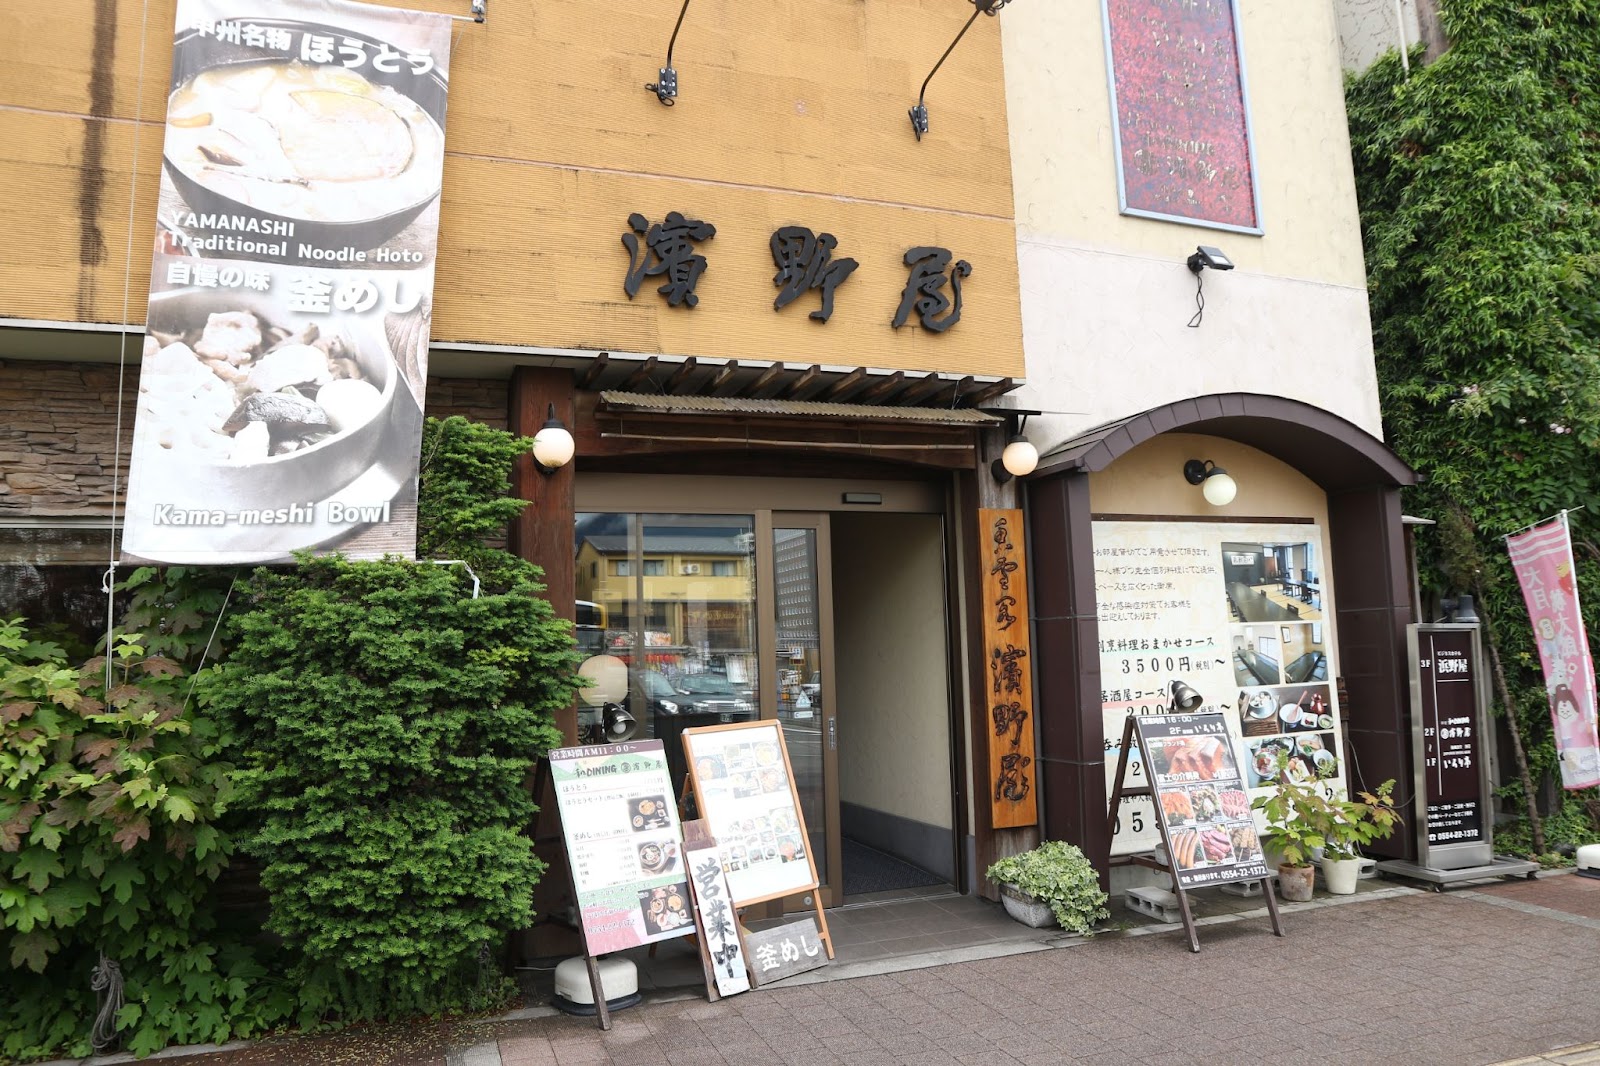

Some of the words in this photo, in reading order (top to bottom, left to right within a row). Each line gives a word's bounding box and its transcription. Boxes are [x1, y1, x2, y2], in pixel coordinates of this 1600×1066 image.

[190, 19, 291, 50] 甲州名物
[300, 33, 434, 75] ほうとう
[172, 211, 295, 237] YAMANASHI
[171, 231, 287, 257] Traditional
[298, 245, 366, 262] Noodle
[377, 248, 423, 262] Hoto
[168, 262, 271, 290] 自慢の味
[288, 273, 422, 314] 釜めし
[153, 502, 313, 526] Kama-meshi
[328, 501, 390, 523] Bowl
[1420, 659, 1431, 668] 3F
[1438, 659, 1468, 673] 浜野屋
[1170, 726, 1181, 735] 2F
[1424, 728, 1435, 737] 2F
[1426, 758, 1437, 767] 1F
[1438, 829, 1479, 840] 0554-22-1372
[1221, 866, 1266, 880] 0554-22-1372
[696, 857, 738, 979] 営業中
[756, 934, 819, 972] 釜めし
